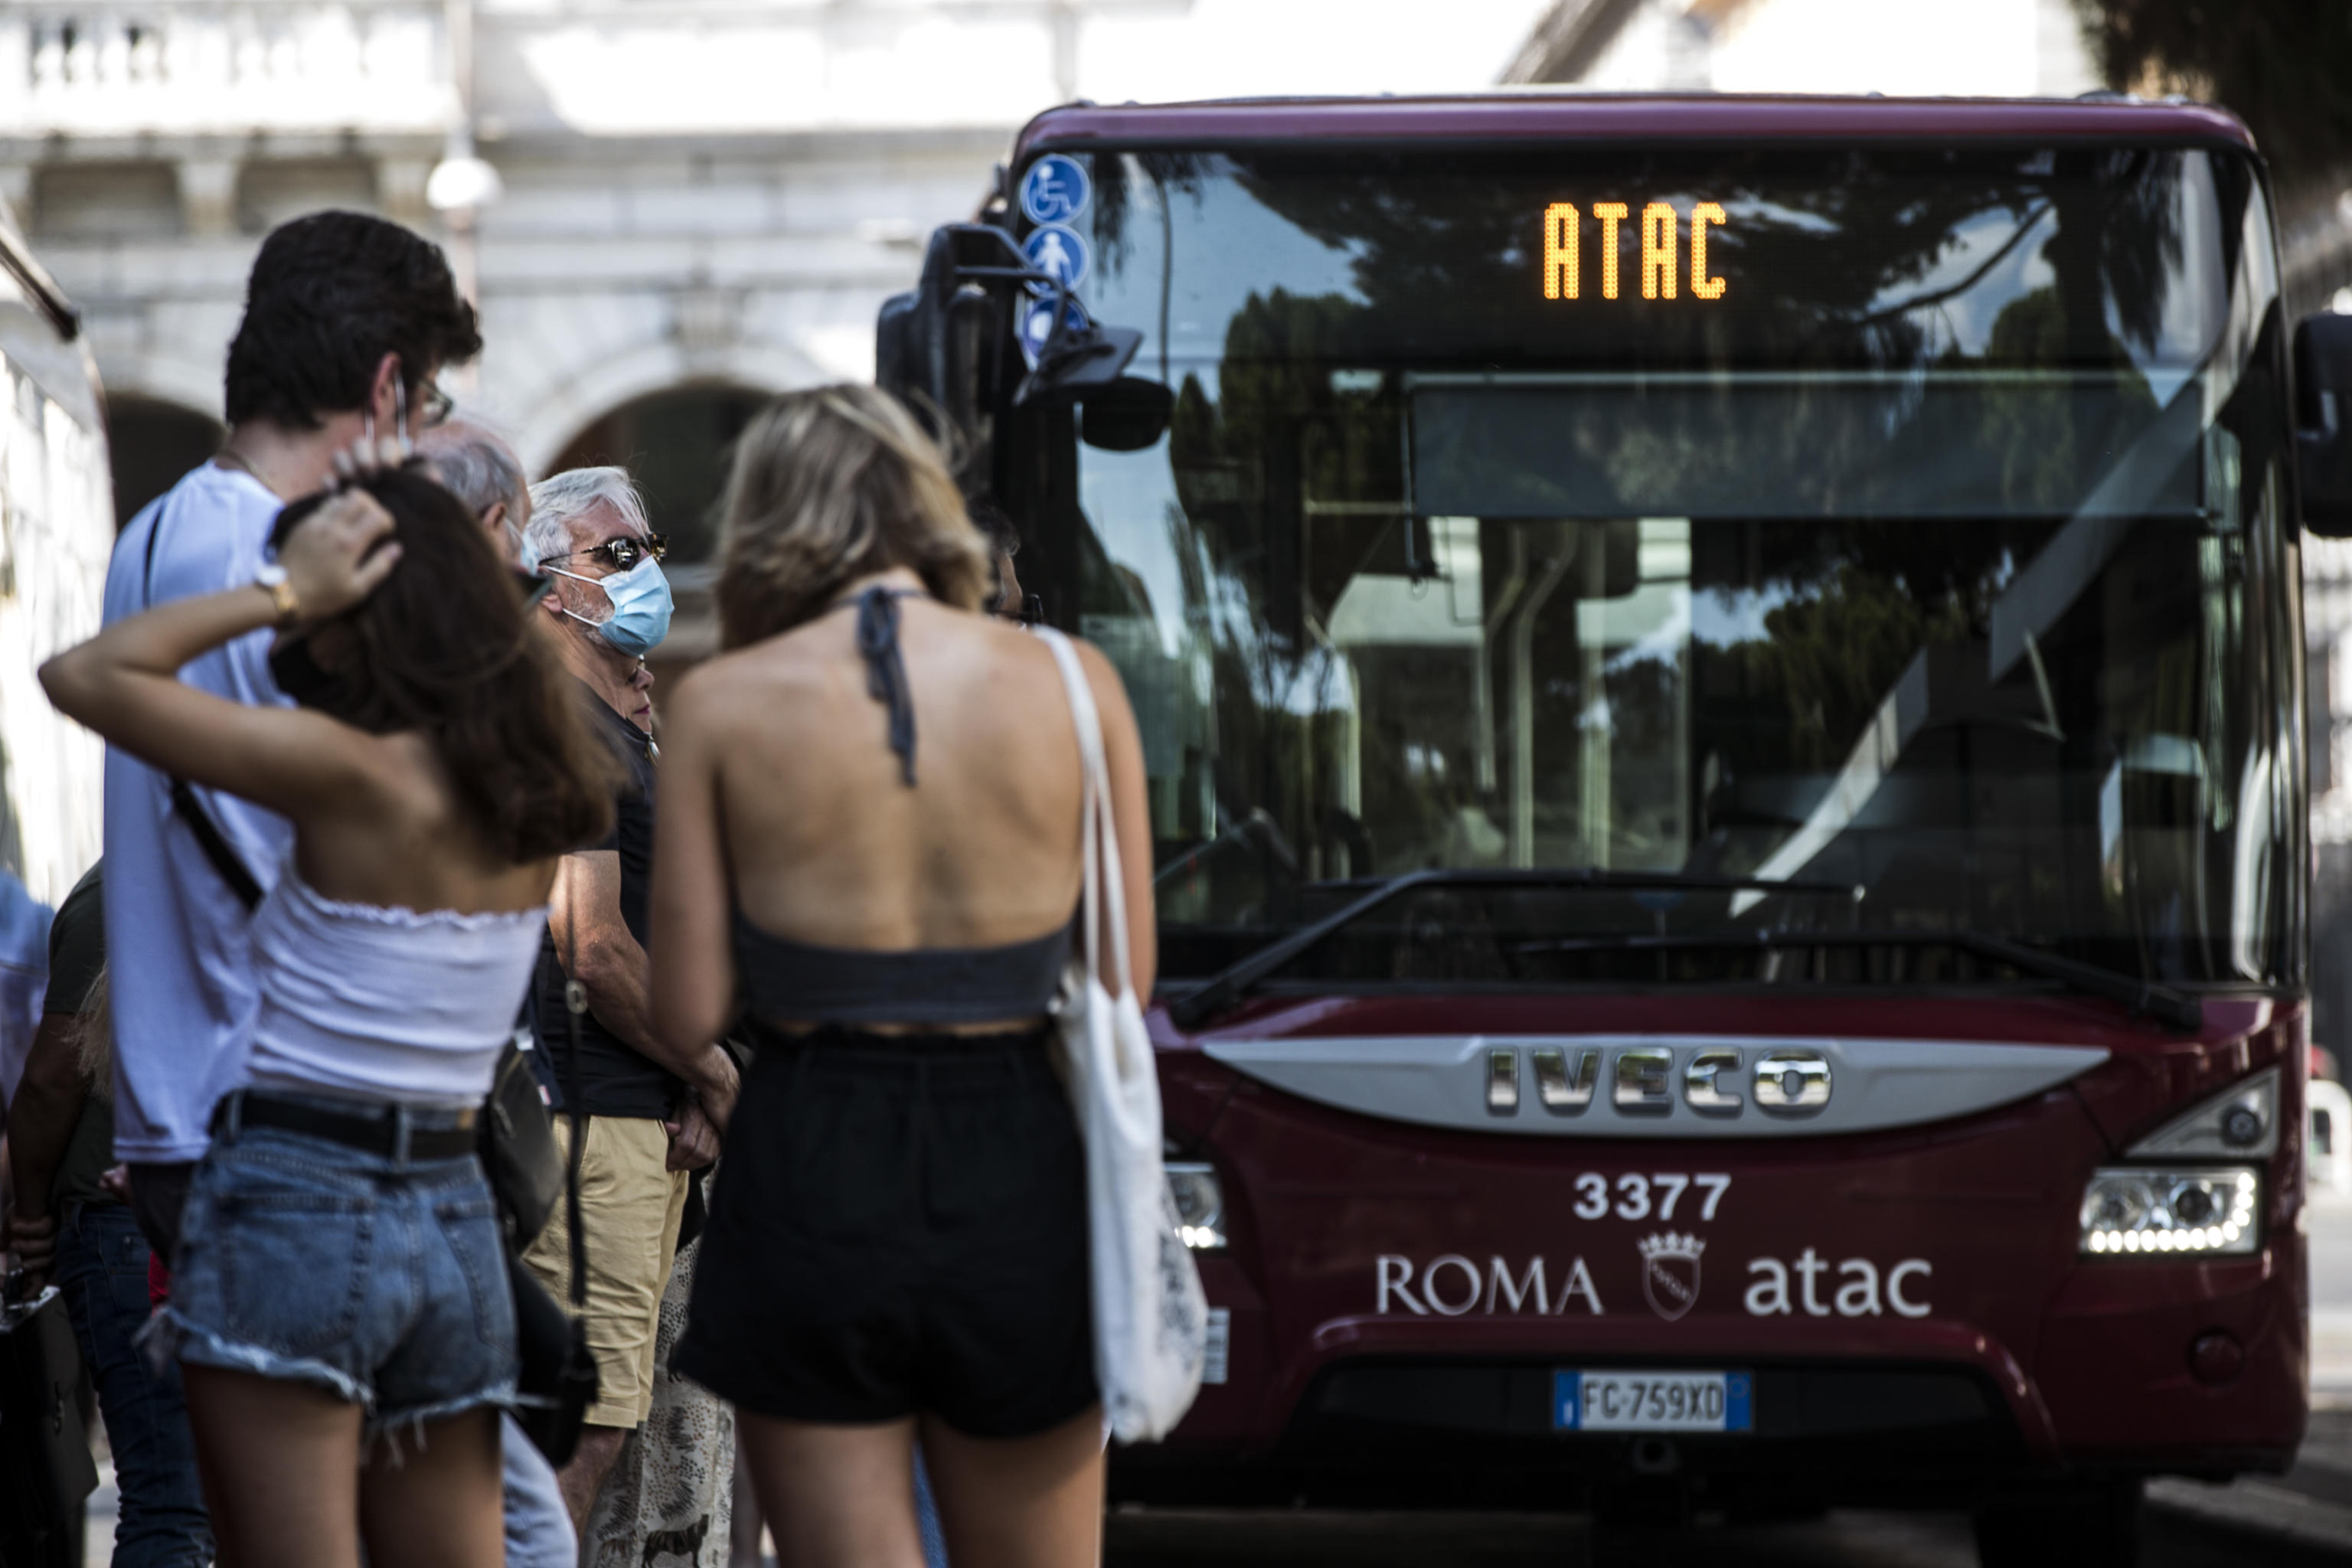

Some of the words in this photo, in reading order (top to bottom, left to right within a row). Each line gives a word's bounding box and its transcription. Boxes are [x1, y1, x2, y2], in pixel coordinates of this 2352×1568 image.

[1544, 201, 1726, 299] ATAC
[1487, 1047, 1832, 1118] IVECO
[1573, 1171, 1732, 1221] 3377
[1376, 1253, 1605, 1316] ROMA
[1743, 1246, 1933, 1318] atac
